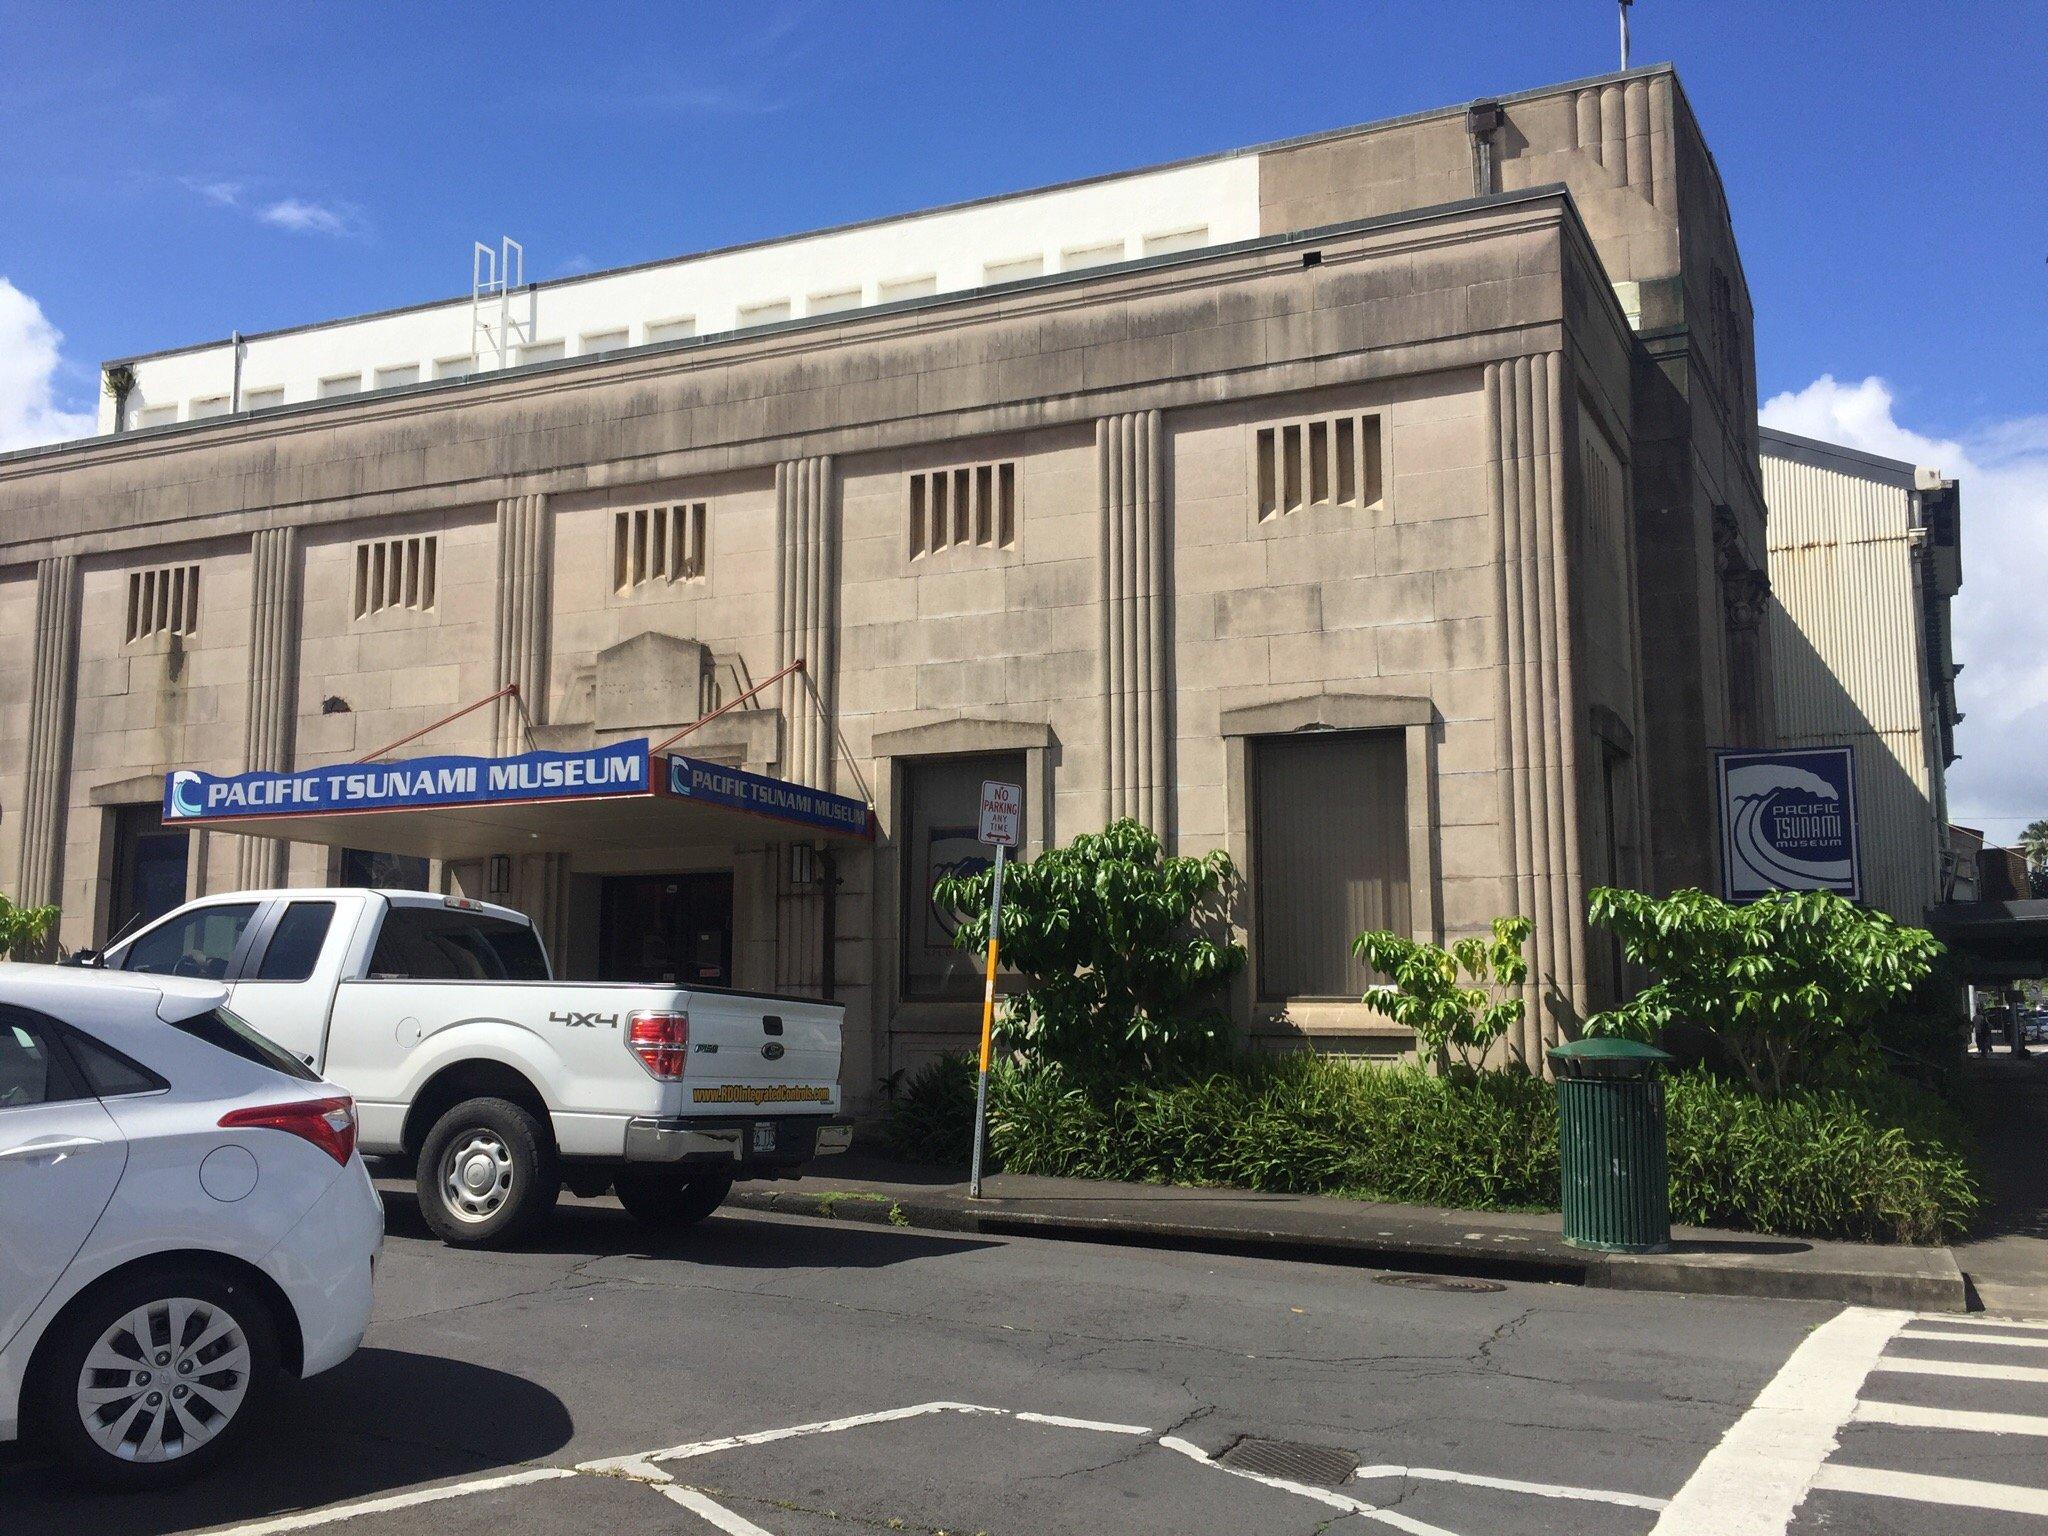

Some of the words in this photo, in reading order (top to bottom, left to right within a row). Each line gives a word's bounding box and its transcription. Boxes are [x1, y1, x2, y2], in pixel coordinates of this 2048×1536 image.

[208, 777, 320, 807] PACIFIC
[327, 767, 477, 801] TSUNAMI
[489, 755, 640, 791] MUSEUM
[692, 769, 747, 799] PACIFIC
[751, 783, 812, 813] TSUNAMI
[815, 798, 866, 826] MUSEUM
[994, 789, 1009, 801] NO
[984, 800, 1018, 815] PARKING
[1773, 803, 1840, 815] PACIFIC
[992, 814, 1008, 823] ANY
[990, 823, 1008, 832] TIME
[1774, 815, 1841, 839] TSUNAMI
[692, 1084, 830, 1106] www.RDOIntegratedControls.com
